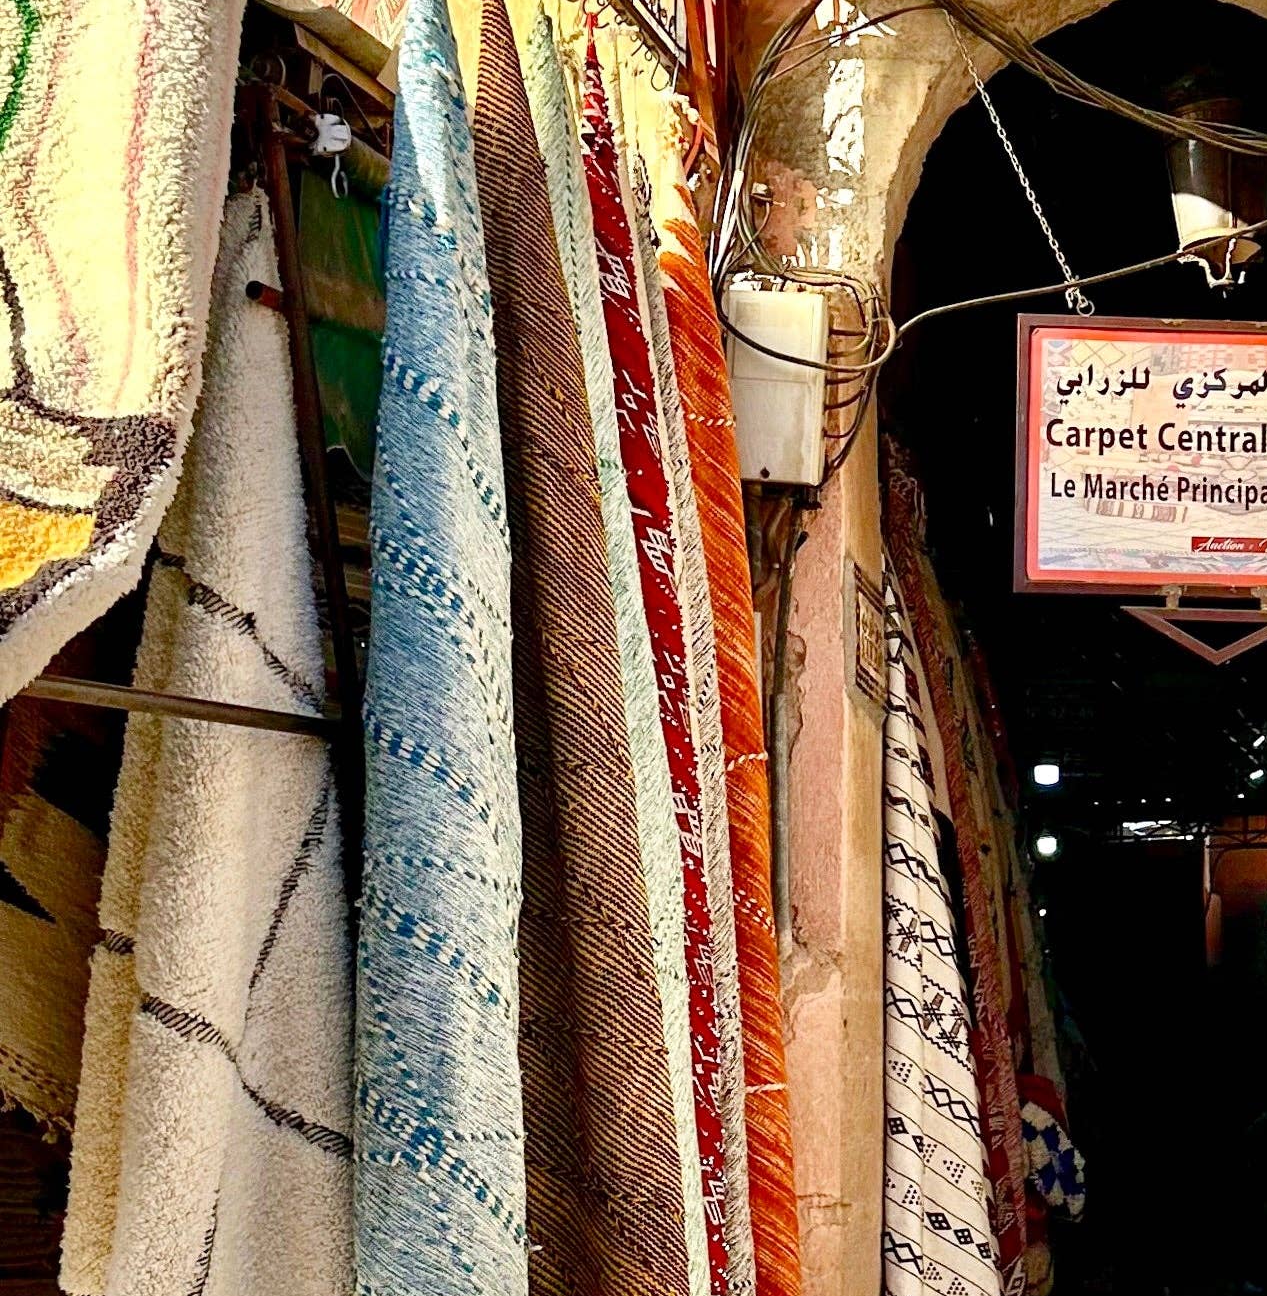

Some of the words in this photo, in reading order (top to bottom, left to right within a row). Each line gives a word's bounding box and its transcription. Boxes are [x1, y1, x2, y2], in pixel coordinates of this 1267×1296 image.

[1056, 364, 1151, 405] للزرابي
[1045, 418, 1148, 456] Carpet
[1158, 422, 1267, 454] Central
[1051, 472, 1076, 499] Le
[1084, 473, 1169, 502] Marché
[1194, 536, 1244, 554] Auction
